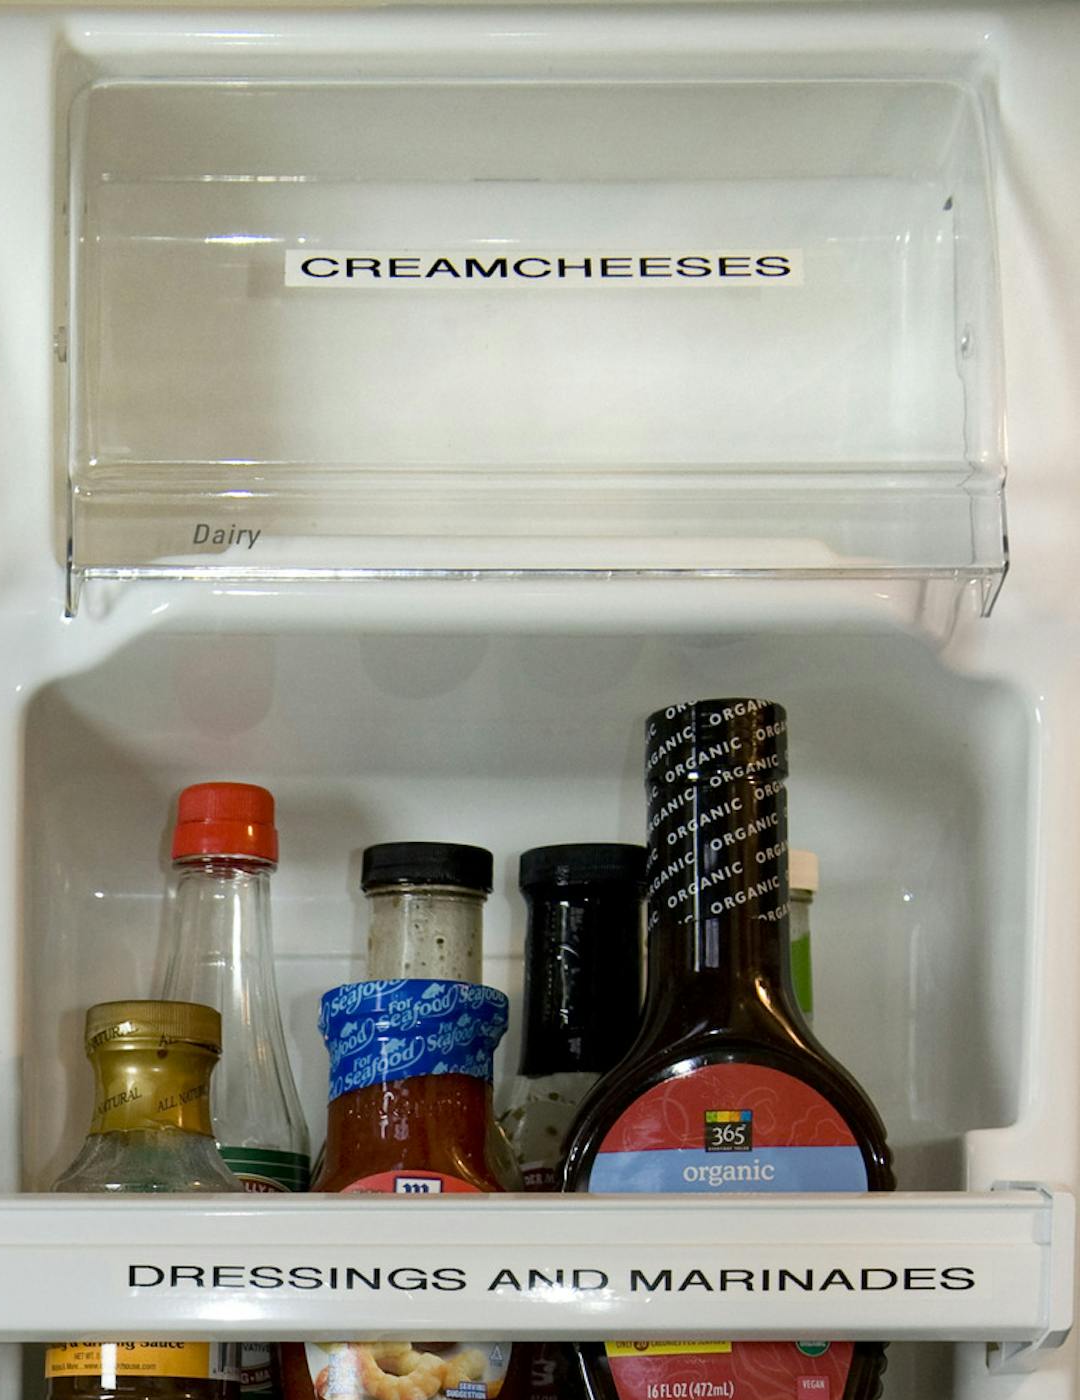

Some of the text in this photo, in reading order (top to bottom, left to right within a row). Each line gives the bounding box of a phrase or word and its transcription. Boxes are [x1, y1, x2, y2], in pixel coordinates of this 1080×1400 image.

[300, 256, 792, 278] CREAMCHEESES
[192, 523, 262, 549] Dairy
[665, 736, 743, 783] ORGANIC
[709, 753, 780, 788] ORGANIC
[667, 797, 744, 845] ORGANIC
[710, 812, 779, 851] ORGANIC
[667, 861, 744, 910] ORGANIC
[710, 875, 781, 915] ORGANIC
[377, 991, 451, 1032] Seafood
[388, 997, 415, 1015] For
[345, 1046, 415, 1089] Seafood
[353, 1055, 373, 1073] For
[157, 1099, 179, 1113] ALL
[711, 1122, 747, 1147] 365
[682, 1159, 775, 1186] organic
[128, 1265, 977, 1292] DRESSINGS AND MARINADES
[647, 1381, 735, 1400] 16 FL OZ (472mL)
[802, 1379, 825, 1389] VEGAN
